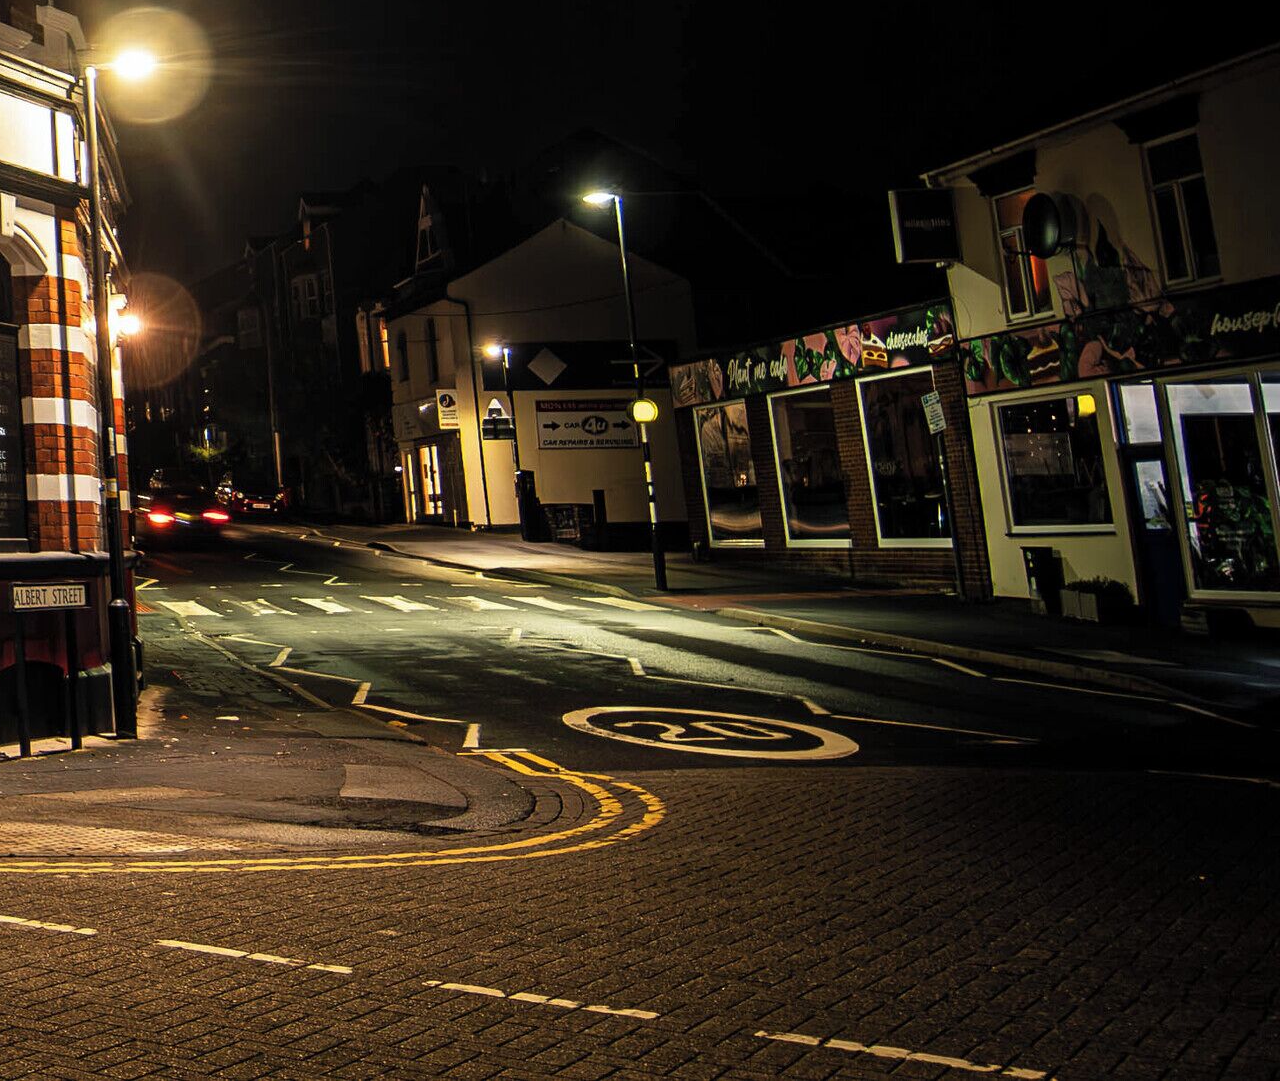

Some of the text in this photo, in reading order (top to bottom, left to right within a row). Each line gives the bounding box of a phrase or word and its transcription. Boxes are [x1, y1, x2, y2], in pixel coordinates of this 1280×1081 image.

[886, 326, 928, 350] cheesecakes
[727, 354, 788, 390] Plant me cafe
[14, 587, 83, 606] ALBERT STREET
[613, 720, 793, 742] 20
